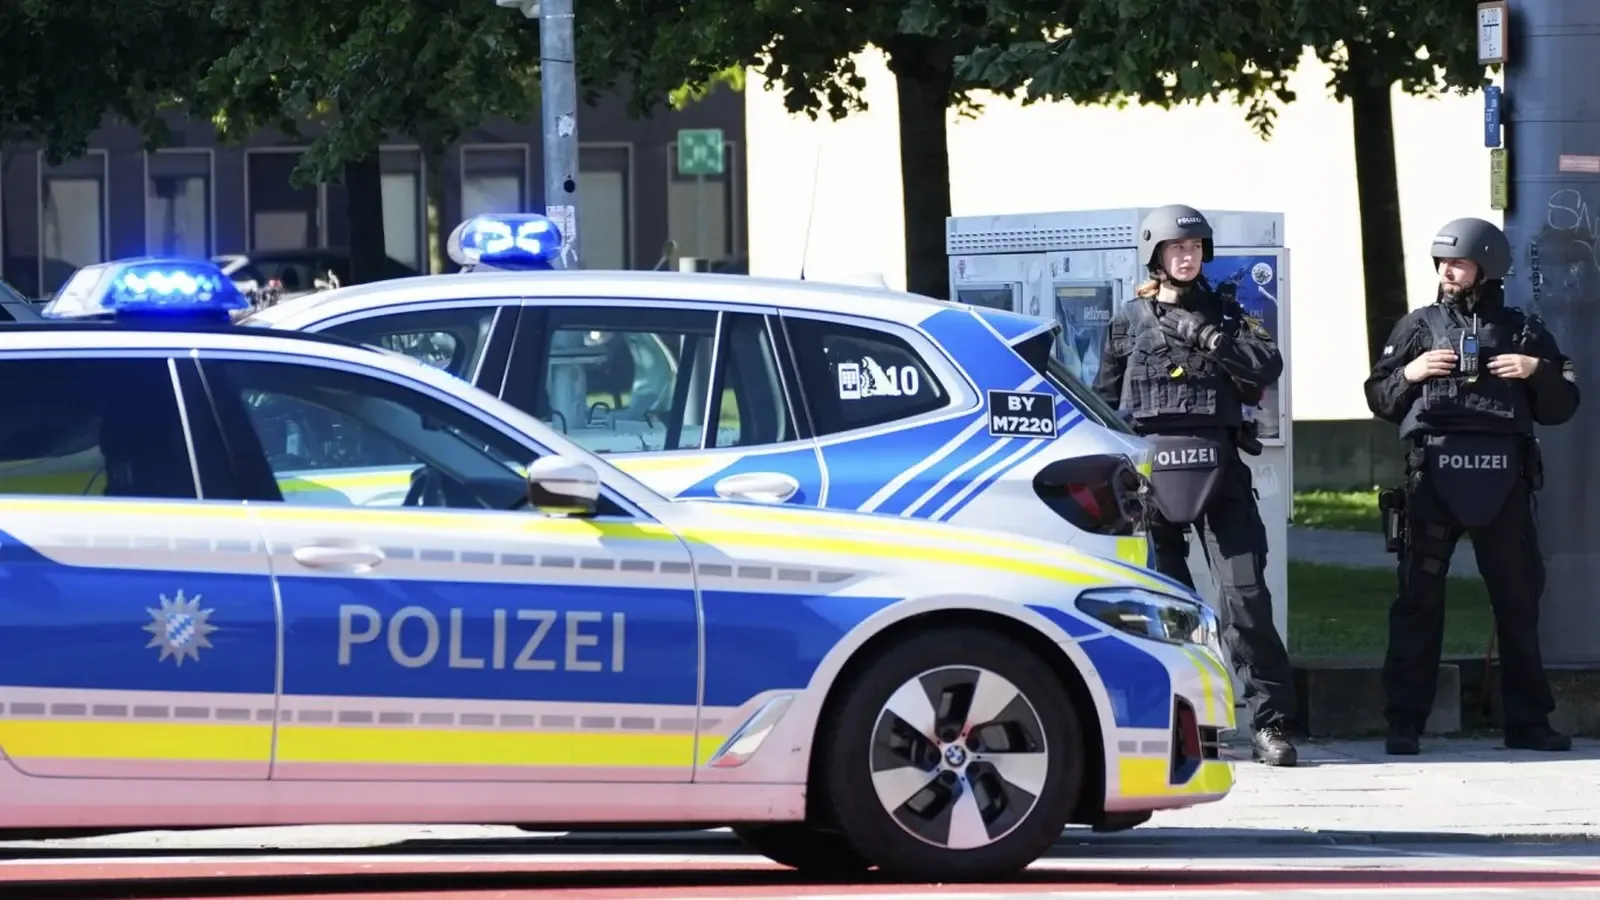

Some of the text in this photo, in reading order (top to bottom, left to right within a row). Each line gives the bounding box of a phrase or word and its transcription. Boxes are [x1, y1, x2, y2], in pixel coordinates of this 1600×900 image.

[1008, 396, 1035, 412] BY
[993, 416, 1053, 434] M7220
[1154, 447, 1215, 466] OLIZEI
[1438, 454, 1508, 470] POLIZEI
[337, 604, 626, 673] POLIZEI
